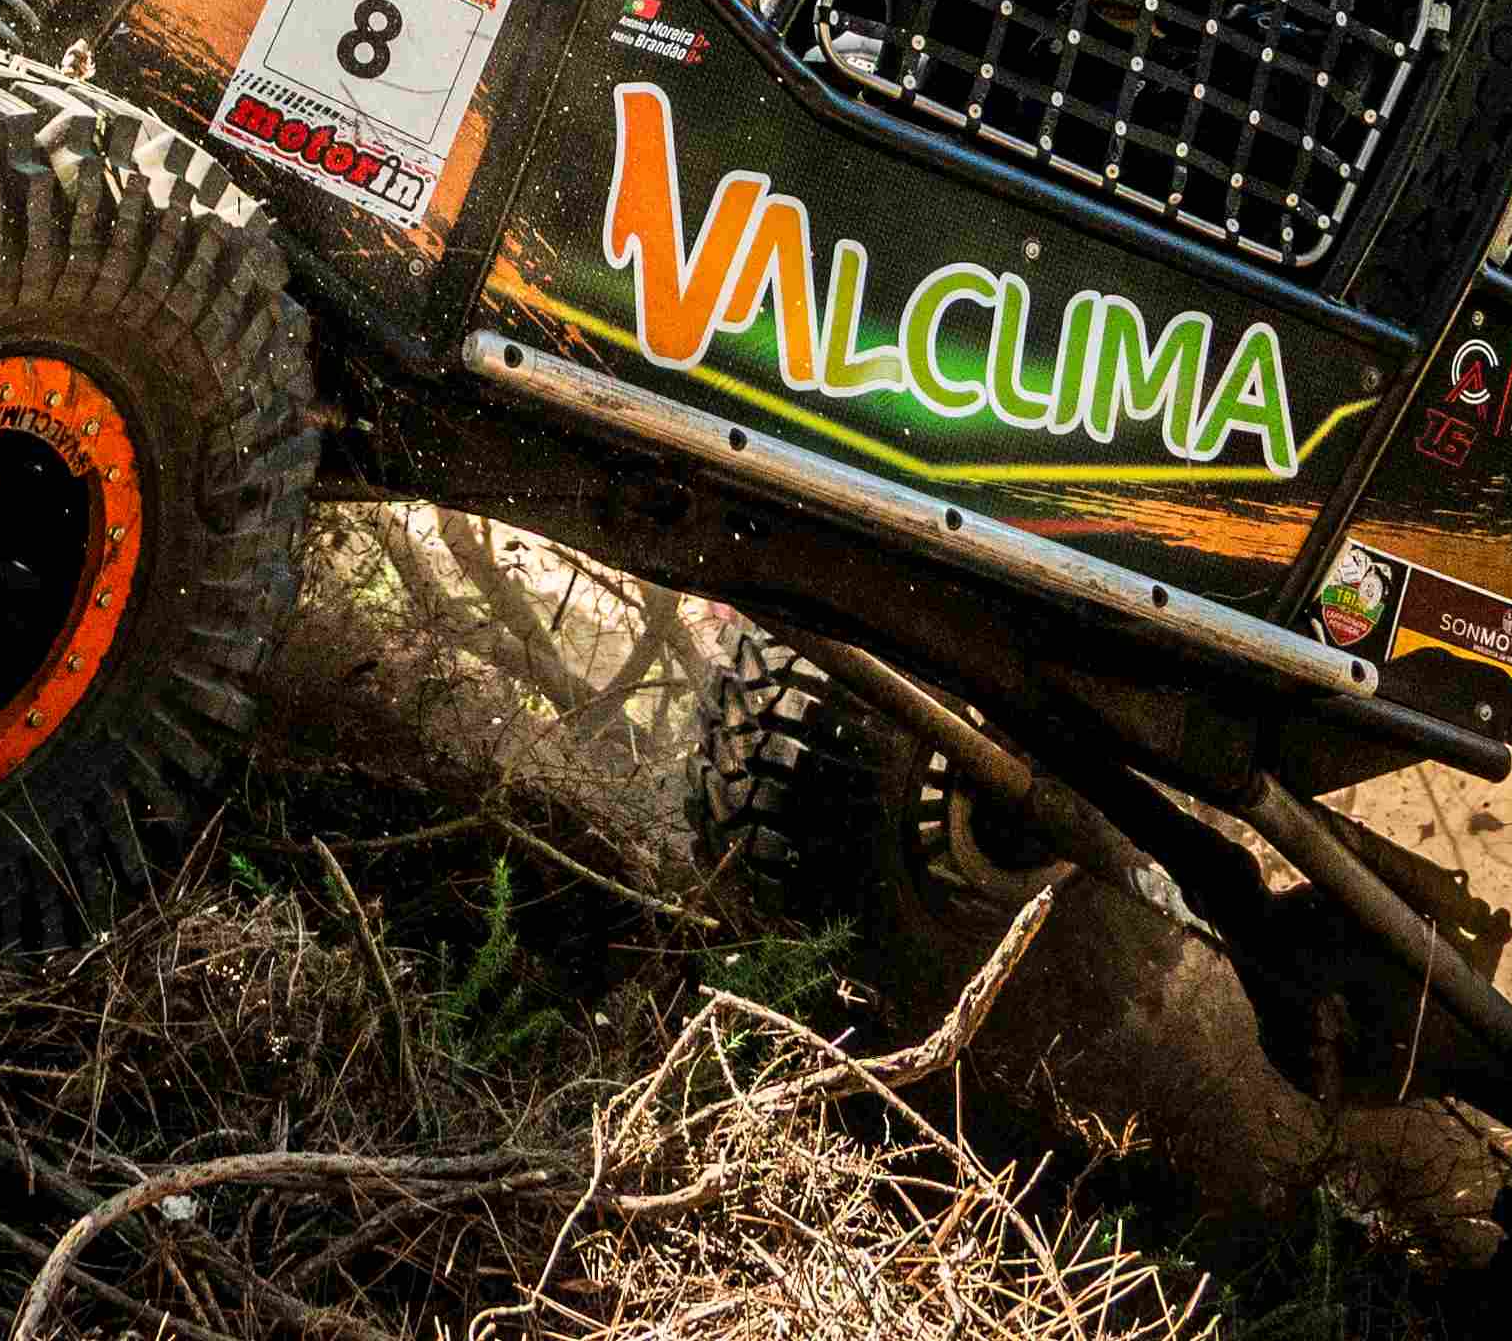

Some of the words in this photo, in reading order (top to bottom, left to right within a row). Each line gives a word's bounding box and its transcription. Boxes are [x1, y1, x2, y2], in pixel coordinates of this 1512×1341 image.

[634, 33, 688, 61] Brandão
[648, 21, 695, 46] Moreira
[224, 92, 425, 213] motorin
[602, 82, 1298, 478] VALCLIMA
